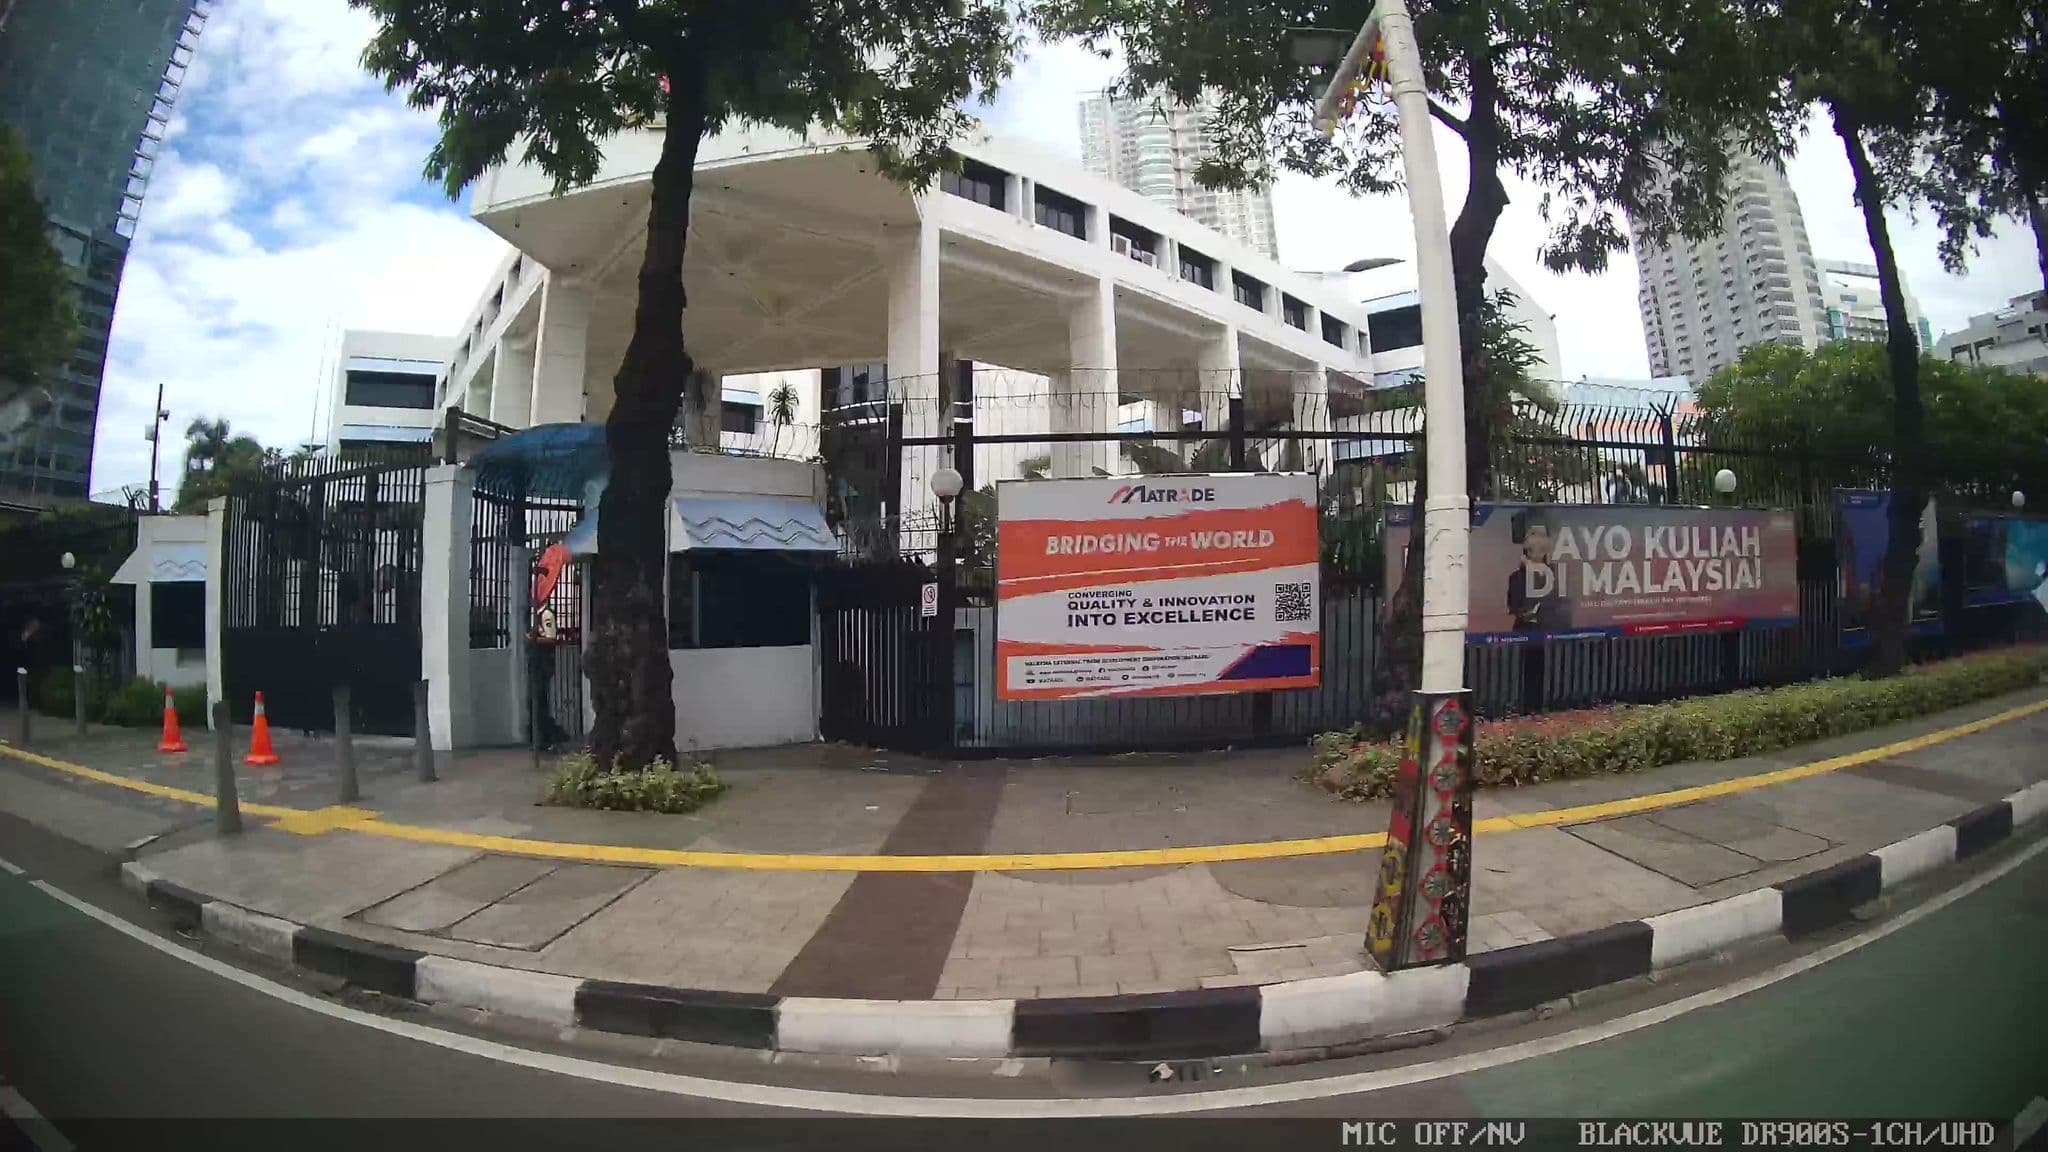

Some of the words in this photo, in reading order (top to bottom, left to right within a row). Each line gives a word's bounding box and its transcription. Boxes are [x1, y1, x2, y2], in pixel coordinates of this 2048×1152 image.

[1107, 485, 1215, 503] MATRADE
[1045, 533, 1160, 555] BRIDGING
[1164, 536, 1187, 547] THE
[1190, 529, 1275, 549] WORLD
[1551, 525, 1633, 561] AYO
[1644, 525, 1761, 559] KULIAH
[1525, 561, 1568, 598] DI
[1582, 558, 1762, 596] MALAYSIA!
[1067, 598, 1137, 611] QUALITY
[1142, 598, 1153, 608] &
[1159, 594, 1256, 607] INNOVATION
[1068, 590, 1133, 599] CONVERGING
[1067, 613, 1117, 628] INTO
[1124, 607, 1256, 626] EXCELLENCE
